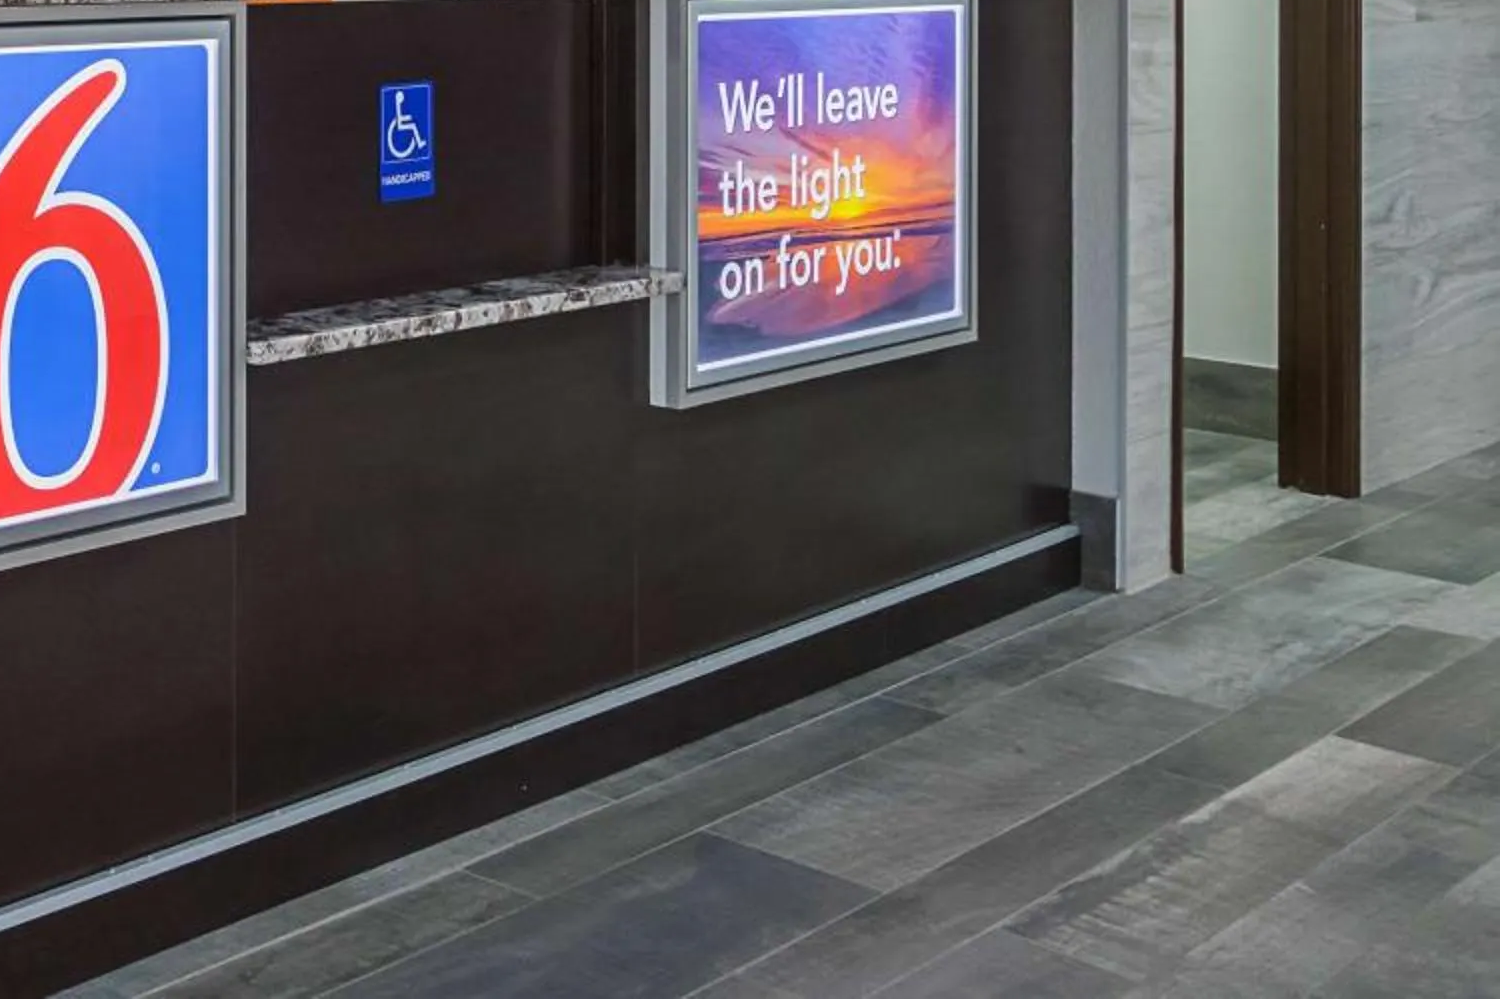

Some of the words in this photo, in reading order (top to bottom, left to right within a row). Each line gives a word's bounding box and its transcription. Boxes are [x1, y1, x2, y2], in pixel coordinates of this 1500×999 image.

[718, 72, 804, 134] We'll
[816, 71, 899, 125] leave
[718, 159, 779, 218] the
[790, 147, 867, 220] light
[718, 256, 764, 300] on
[775, 233, 828, 290] for
